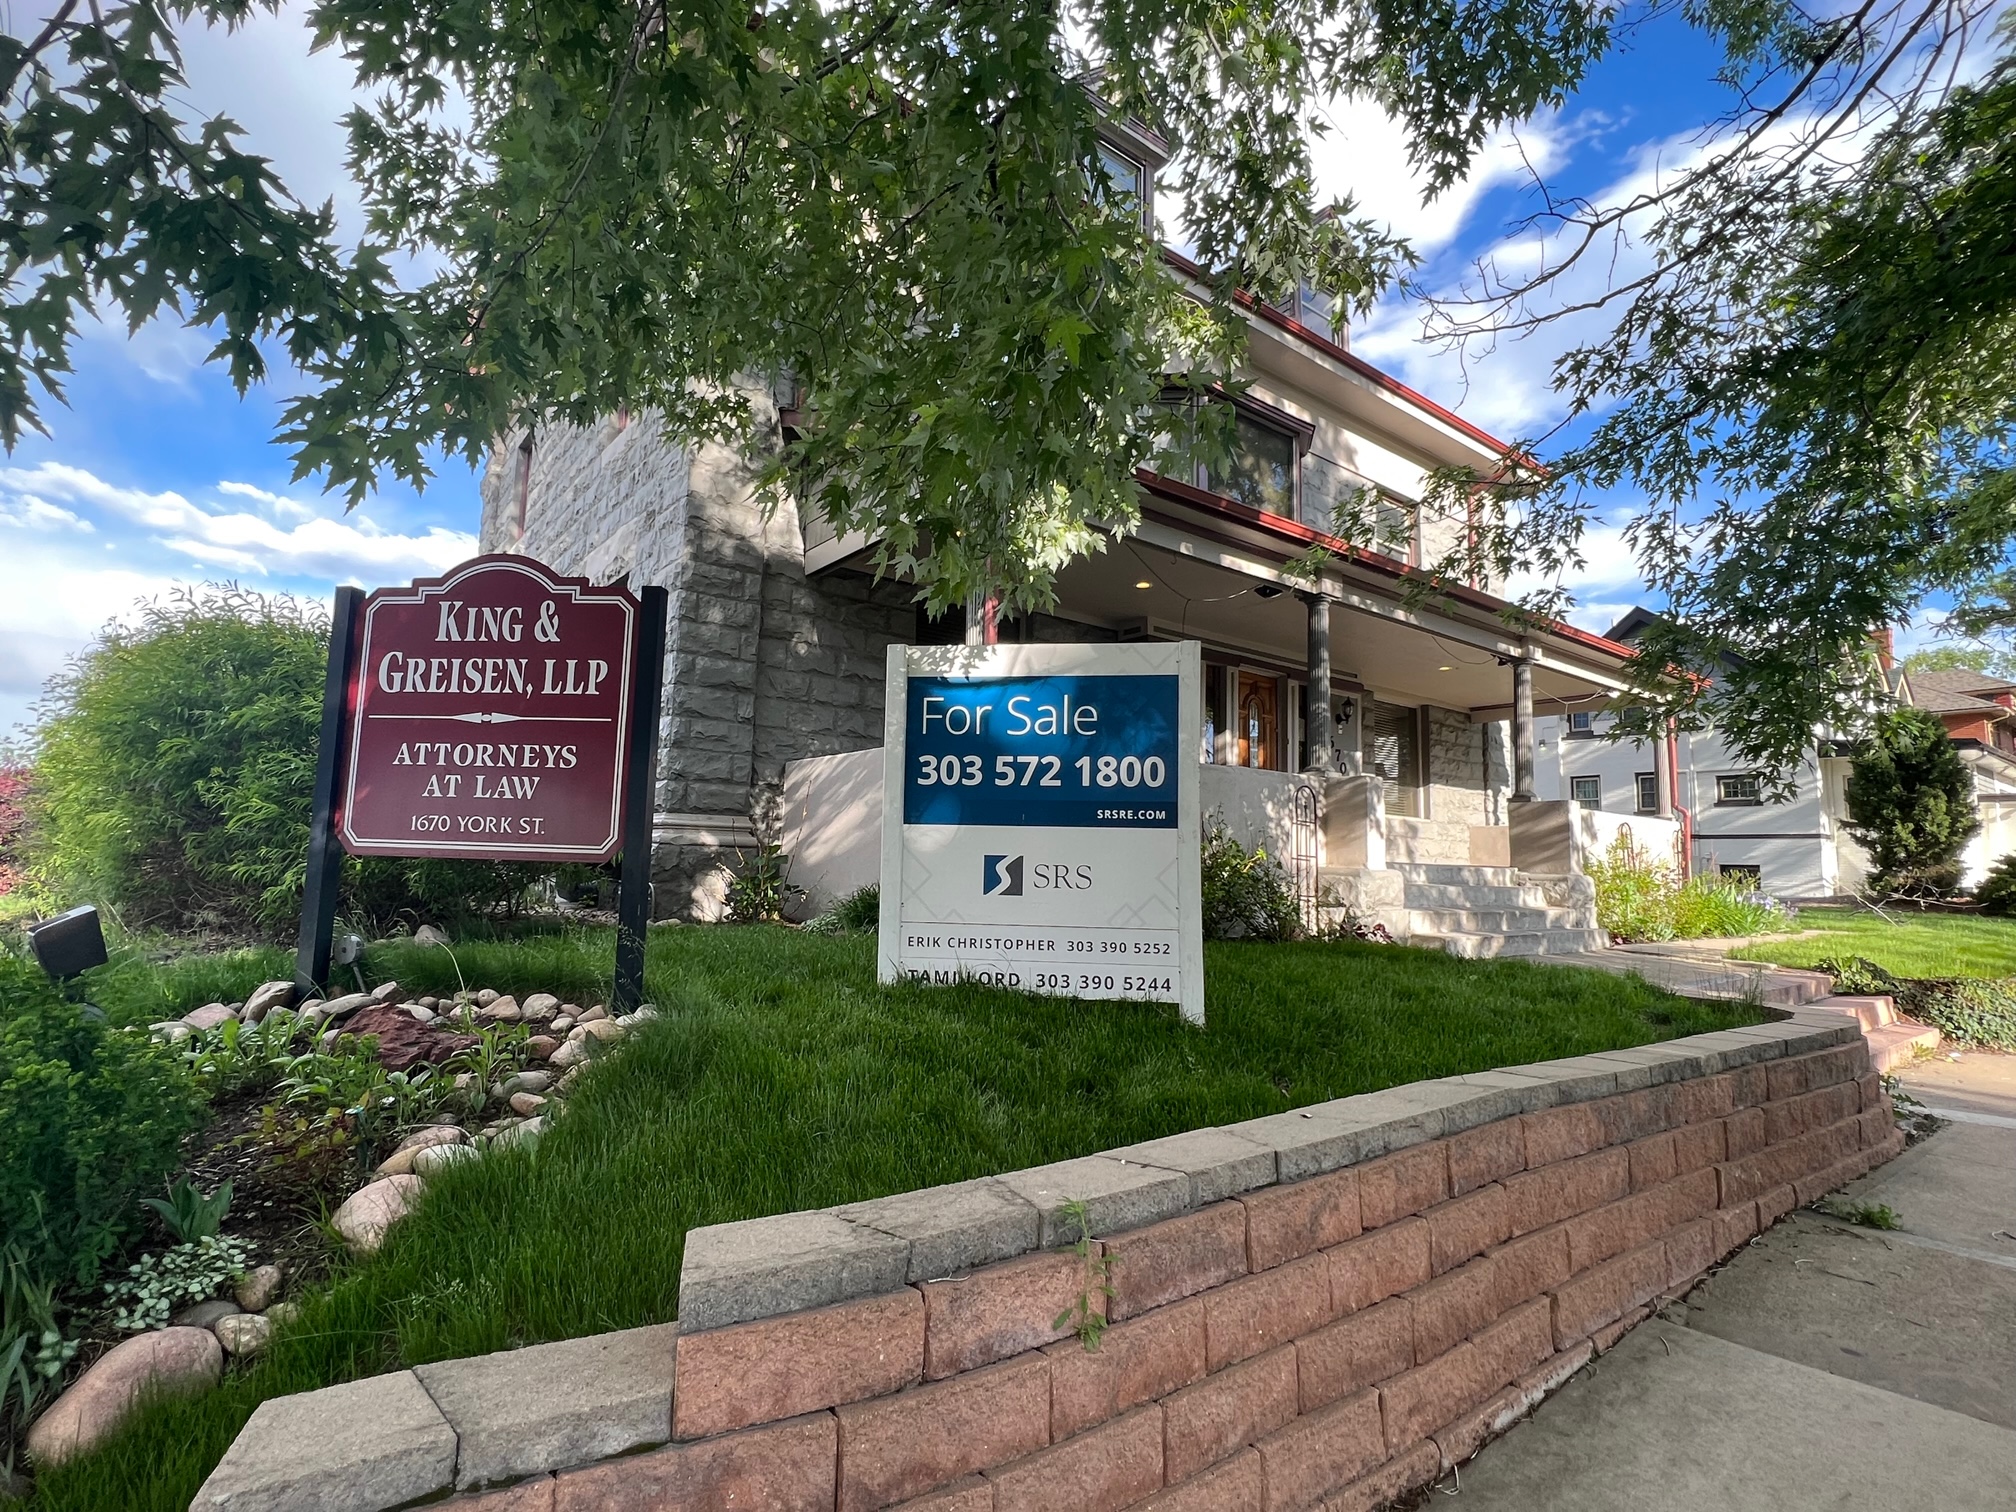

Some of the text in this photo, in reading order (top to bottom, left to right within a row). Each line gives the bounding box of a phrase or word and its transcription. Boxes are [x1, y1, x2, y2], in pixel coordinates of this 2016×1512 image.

[434, 600, 561, 643] KING &
[378, 651, 608, 699] GREISEN, LLP
[921, 694, 1098, 736] For Sale
[392, 742, 577, 769] ATTORNEYS
[917, 755, 1166, 788] 303 572 1800
[421, 774, 541, 800] AT LAW
[410, 814, 546, 835] 1670 YORK ST.
[1096, 809, 1167, 820] SRSRE.COM
[1033, 863, 1092, 890] SRS
[907, 936, 1171, 955] ERIK CHRISTOPHER 303 390 5252
[1035, 973, 1071, 989] 303
[1079, 975, 1115, 990] 390
[1123, 976, 1172, 993] 5244
